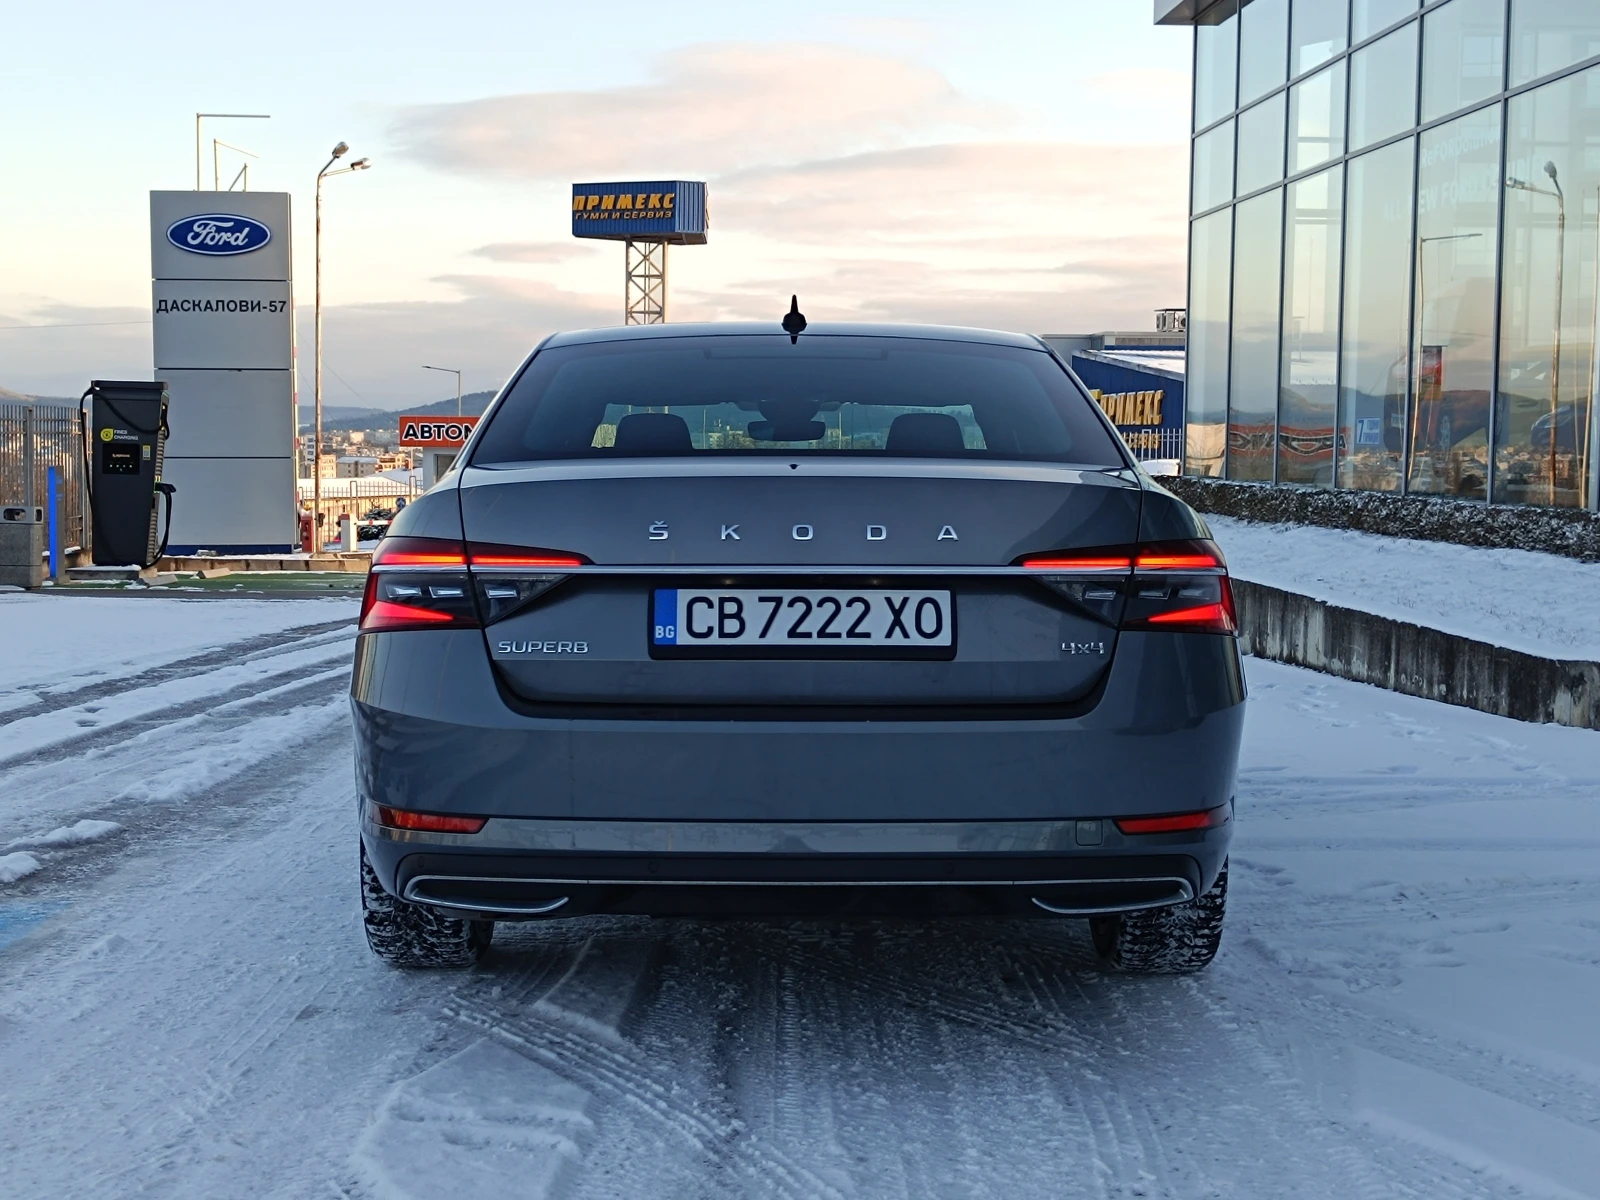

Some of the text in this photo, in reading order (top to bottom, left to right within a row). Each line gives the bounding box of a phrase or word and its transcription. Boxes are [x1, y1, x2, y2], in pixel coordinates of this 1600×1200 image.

[573, 193, 675, 211] ПРИМЕКС
[575, 212, 608, 220] ГУМИ
[623, 211, 672, 219] СЕРВИЗ
[187, 220, 250, 246] Ford
[156, 299, 287, 314] ДАСКАЛОВИ-57
[686, 597, 746, 639] CB
[757, 596, 872, 639] 7222
[655, 626, 675, 639] BG
[498, 640, 589, 654] SUPERB
[1061, 642, 1105, 655] 4x4
